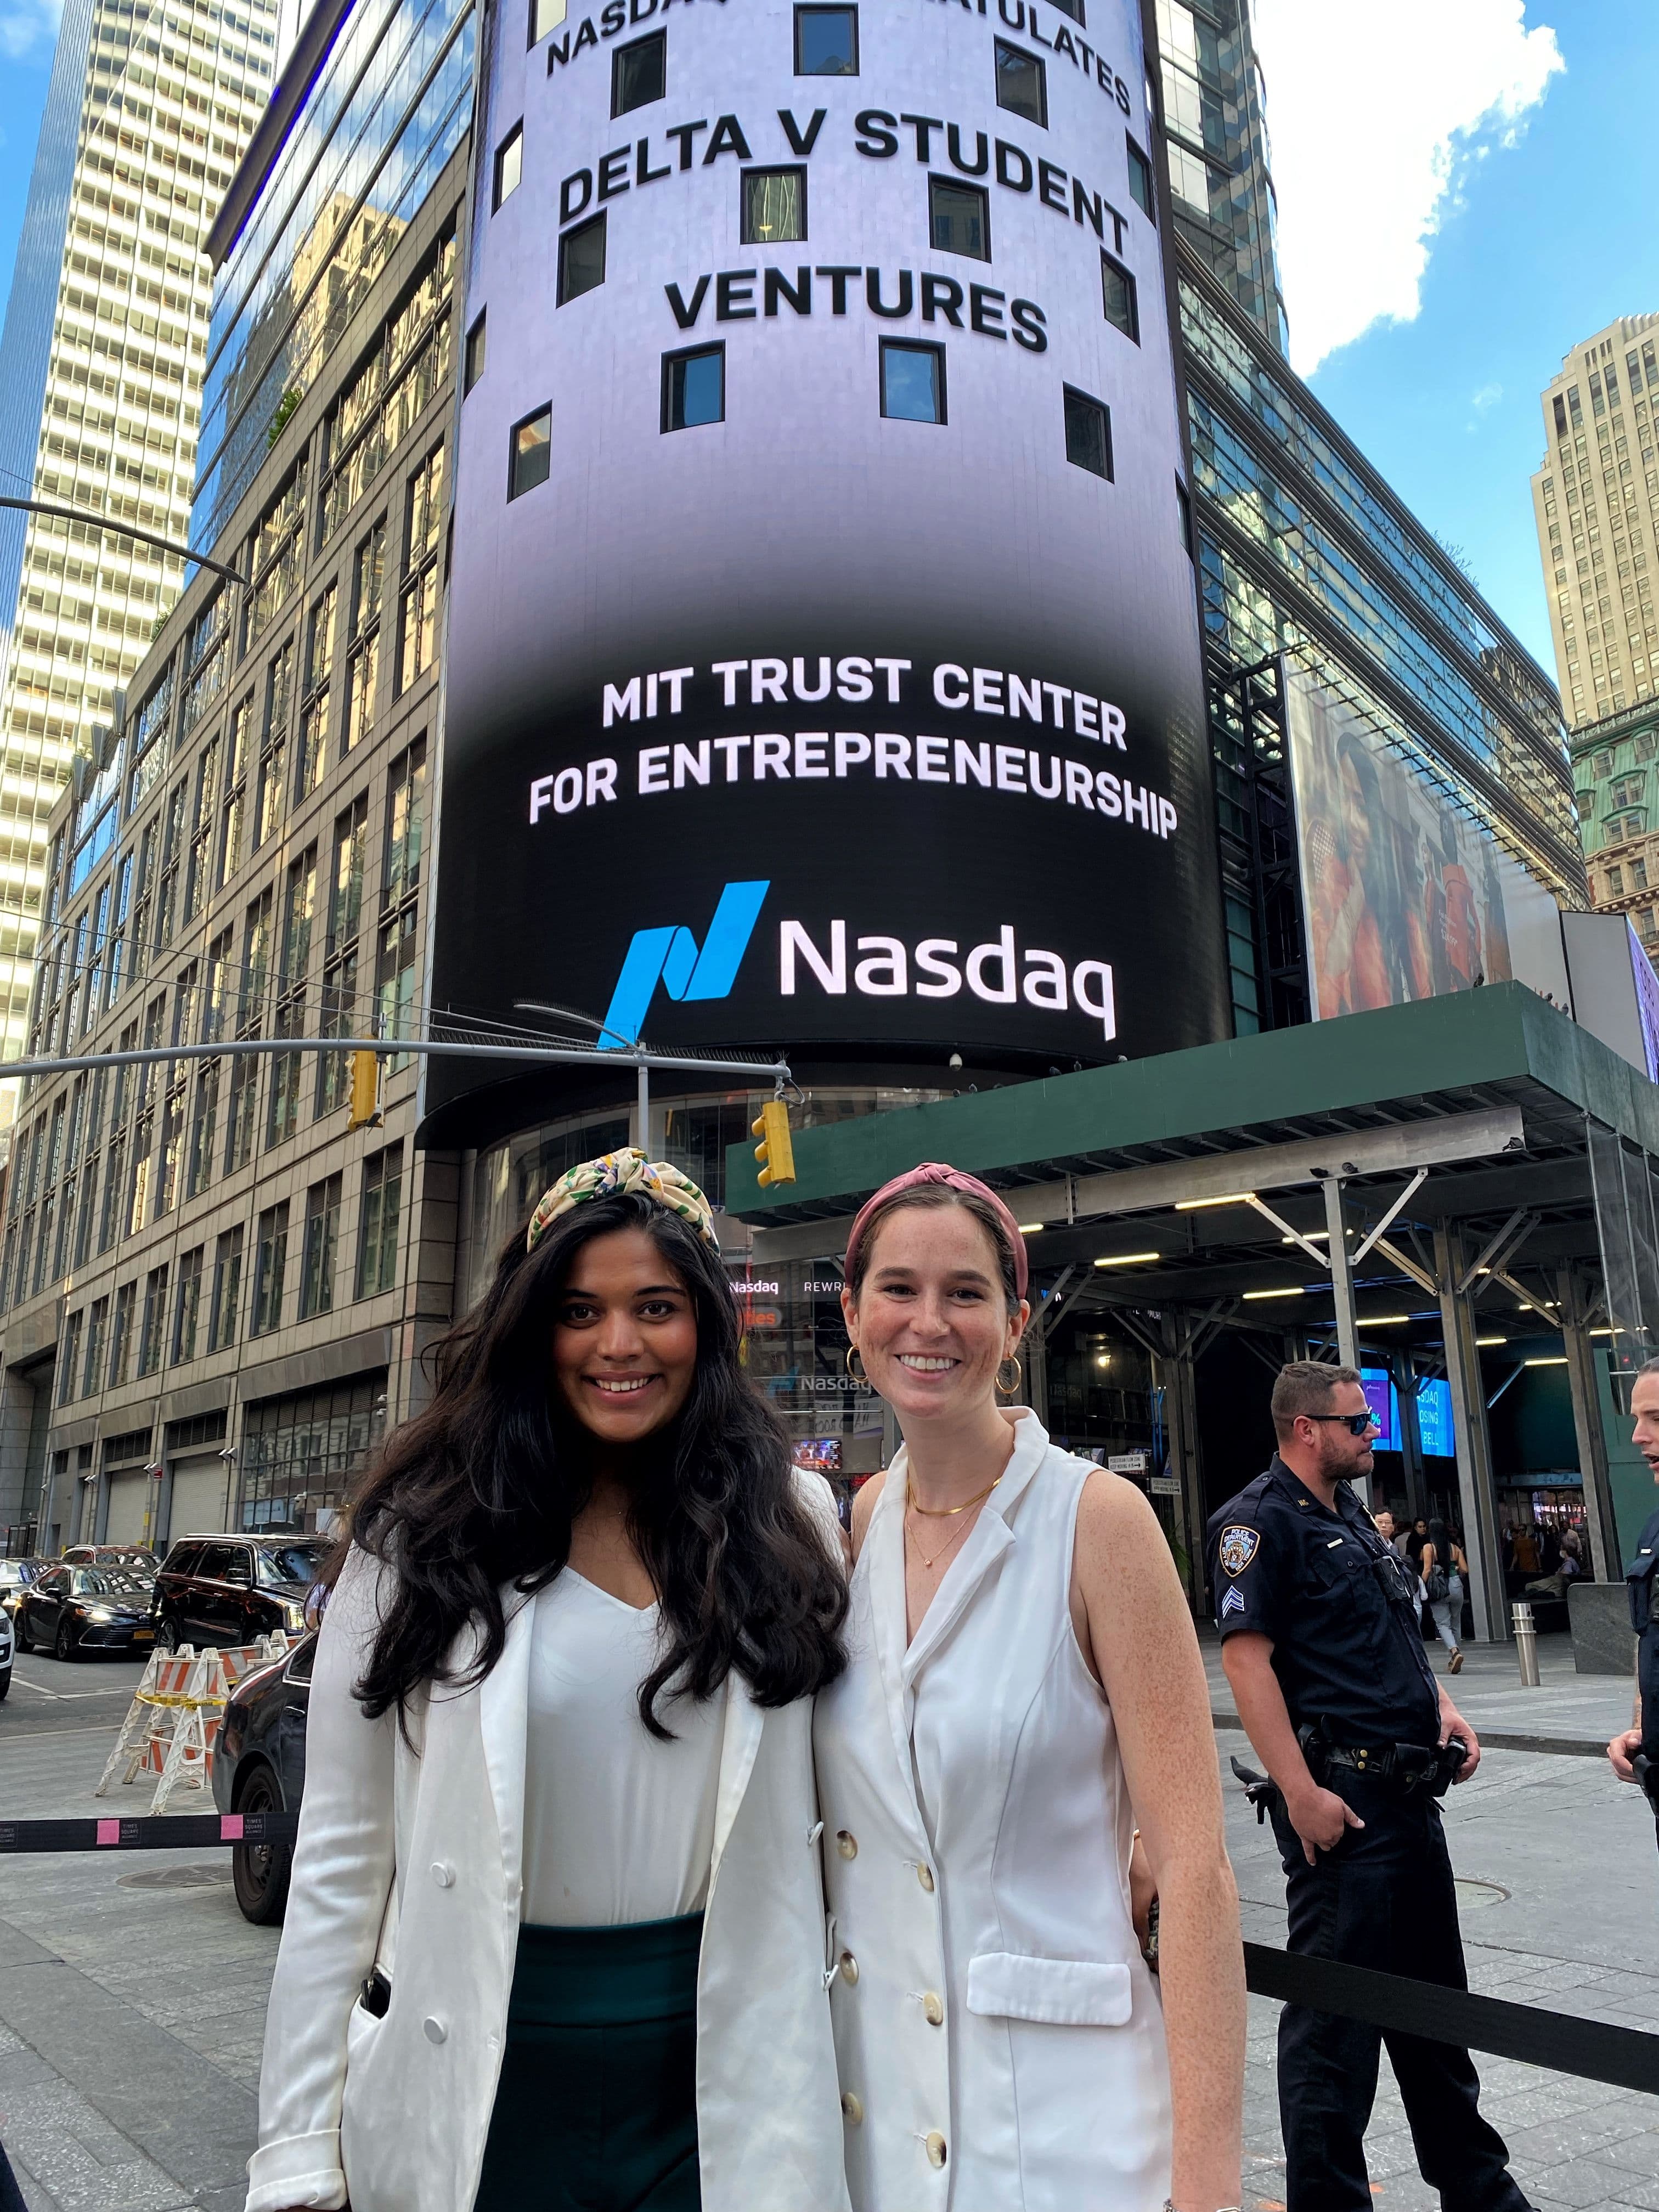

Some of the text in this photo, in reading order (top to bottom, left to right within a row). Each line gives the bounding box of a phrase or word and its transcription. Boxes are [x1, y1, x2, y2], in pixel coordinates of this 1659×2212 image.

[559, 109, 1129, 257] DELTA V STUDENT
[664, 266, 1048, 353] VENTURES
[603, 657, 1128, 751] MIT TRUST CENTER
[529, 732, 1178, 839] FOR ENTREPRENEURSHIP
[780, 919, 1116, 1042] Nasdaq
[729, 1280, 779, 1295] Nasdaq
[801, 1374, 872, 1395] Nasdaq
[1423, 1431, 1439, 1446] BELL
[1224, 1534, 1255, 1547] DEPARTMENT
[1231, 1529, 1250, 1537] POLICE
[1235, 1561, 1244, 1572] NEW
